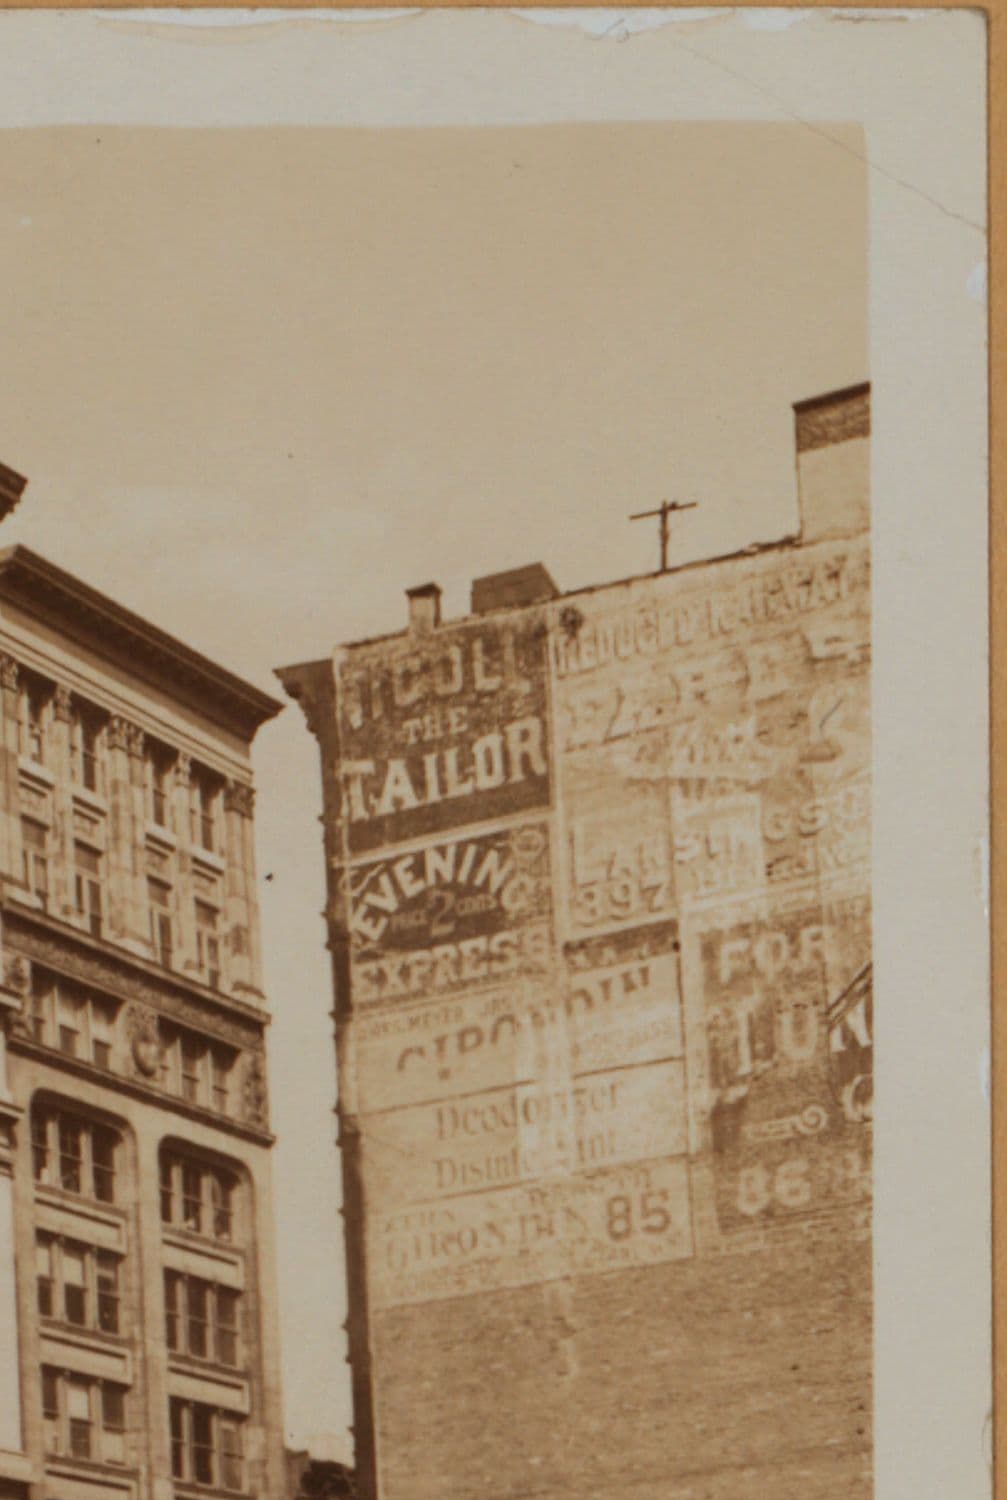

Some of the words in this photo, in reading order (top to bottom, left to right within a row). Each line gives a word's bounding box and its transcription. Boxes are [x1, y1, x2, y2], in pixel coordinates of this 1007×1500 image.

[403, 706, 469, 744] THE
[335, 715, 546, 822] TAILOR
[350, 843, 537, 943] EVENING
[427, 888, 457, 939] 2
[352, 925, 548, 1003] EXPRESS
[606, 1189, 672, 1243] 85
